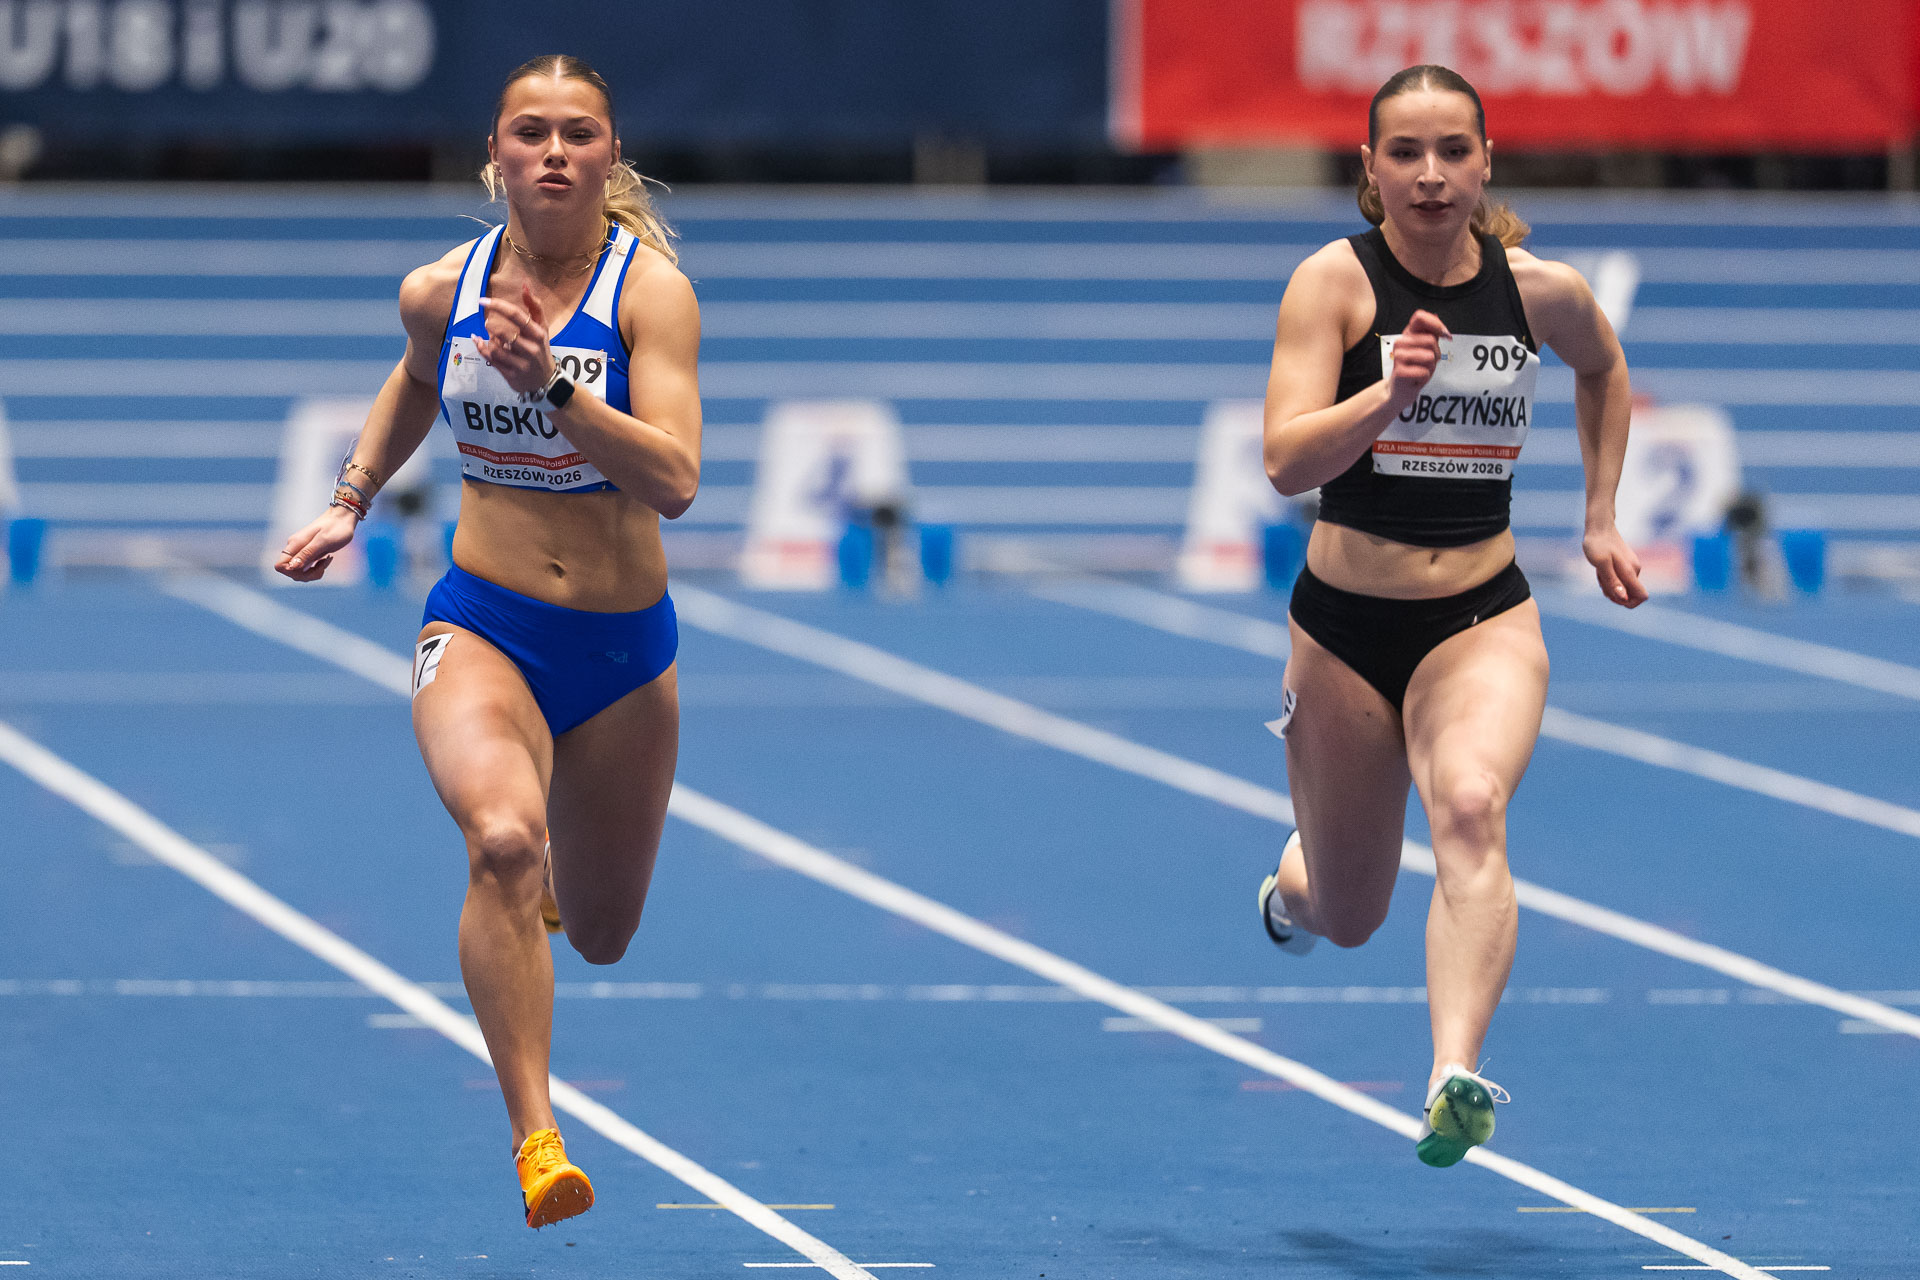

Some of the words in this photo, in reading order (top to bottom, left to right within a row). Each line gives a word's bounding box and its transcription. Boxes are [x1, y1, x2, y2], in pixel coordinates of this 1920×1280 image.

[552, 354, 603, 384] 09
[1472, 345, 1528, 371] 909
[463, 401, 559, 440] BISKU
[1399, 390, 1527, 427] OBCZYŃSKA
[478, 449, 499, 462] Halowe
[501, 456, 545, 466] Mistrzostwa
[546, 458, 569, 468] Polski
[1429, 446, 1473, 454] Mistrzostwa
[483, 464, 545, 482] RZESZÓW
[548, 470, 582, 485] 2026
[1402, 460, 1469, 474] RZESZÓW
[1472, 463, 1503, 474] 2026
[416, 638, 440, 690] 7
